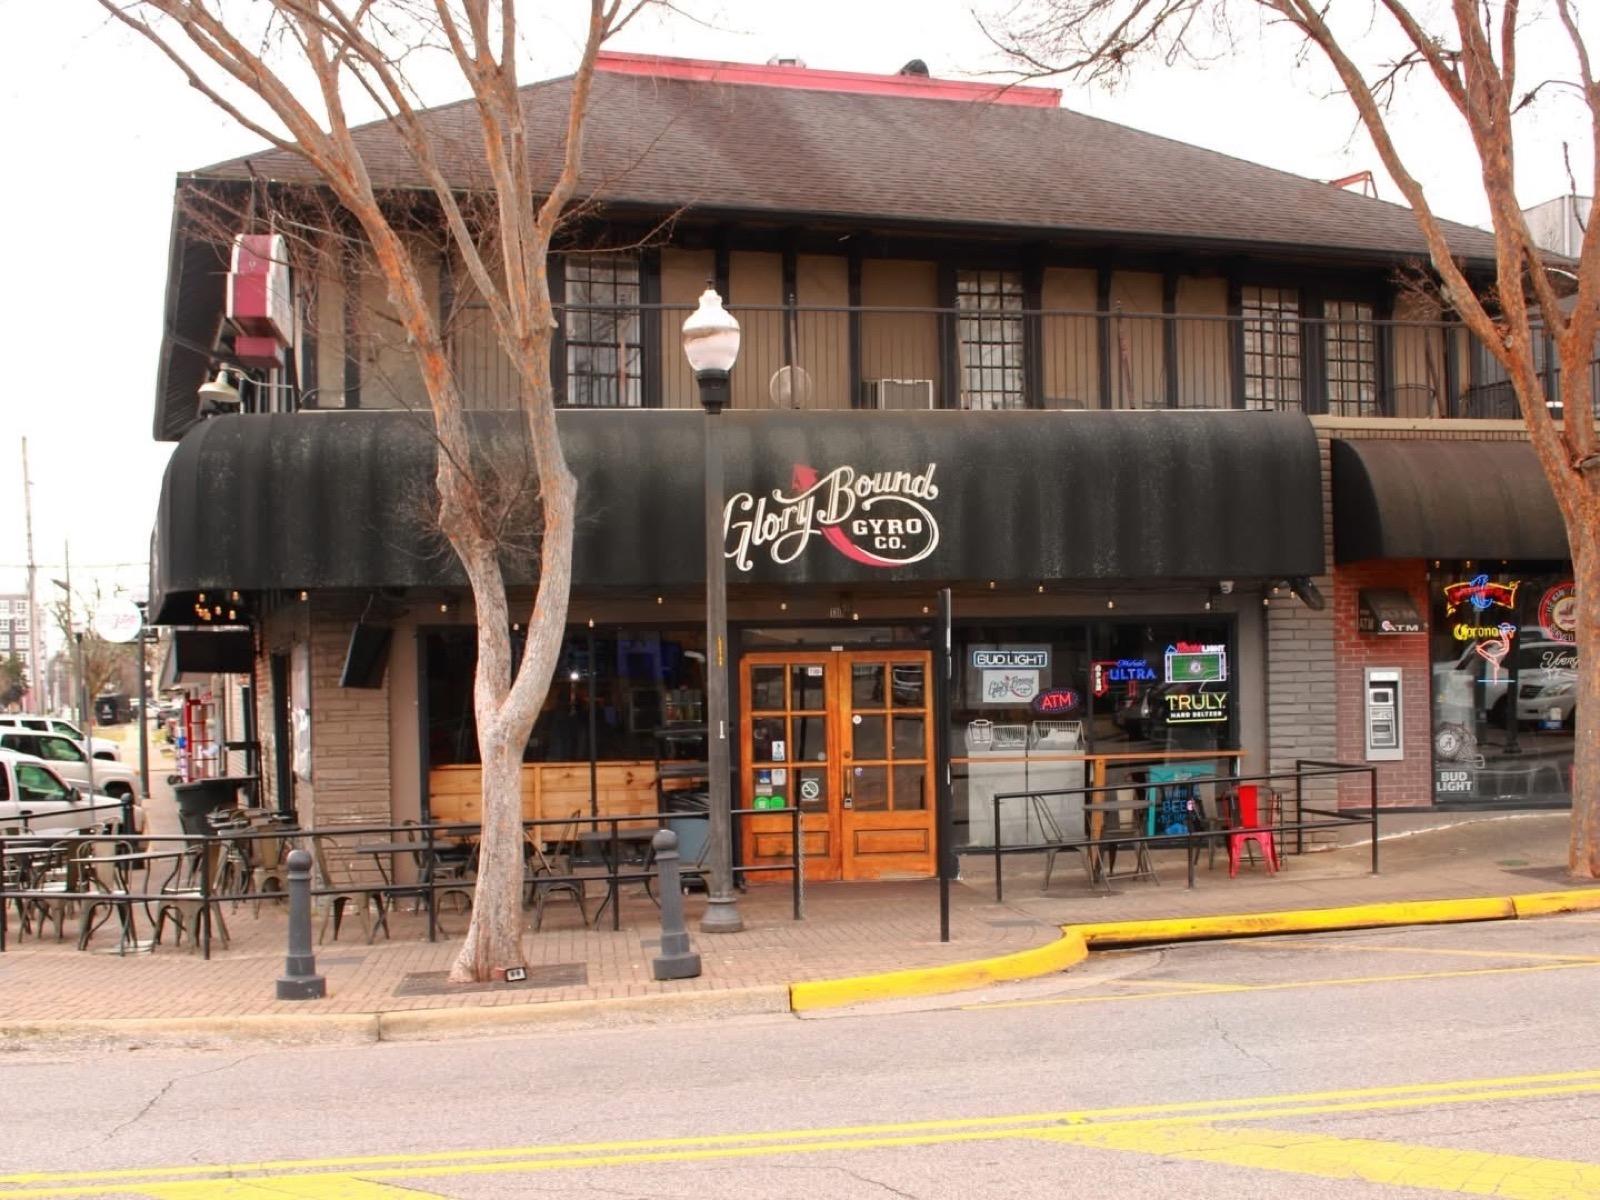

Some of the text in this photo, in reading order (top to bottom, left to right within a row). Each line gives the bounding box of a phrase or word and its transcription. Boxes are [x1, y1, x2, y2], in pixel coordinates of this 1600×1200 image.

[722, 463, 939, 571] Glory Bound
[852, 518, 922, 535] GYRO
[874, 536, 907, 550] CO.
[1454, 624, 1500, 641] Corona
[977, 654, 1044, 665] BUD LIGHT
[1108, 668, 1156, 680] ULTRA
[1042, 692, 1072, 710] ATM
[1440, 771, 1468, 782] BUD
[1436, 781, 1473, 792] LIGHT
